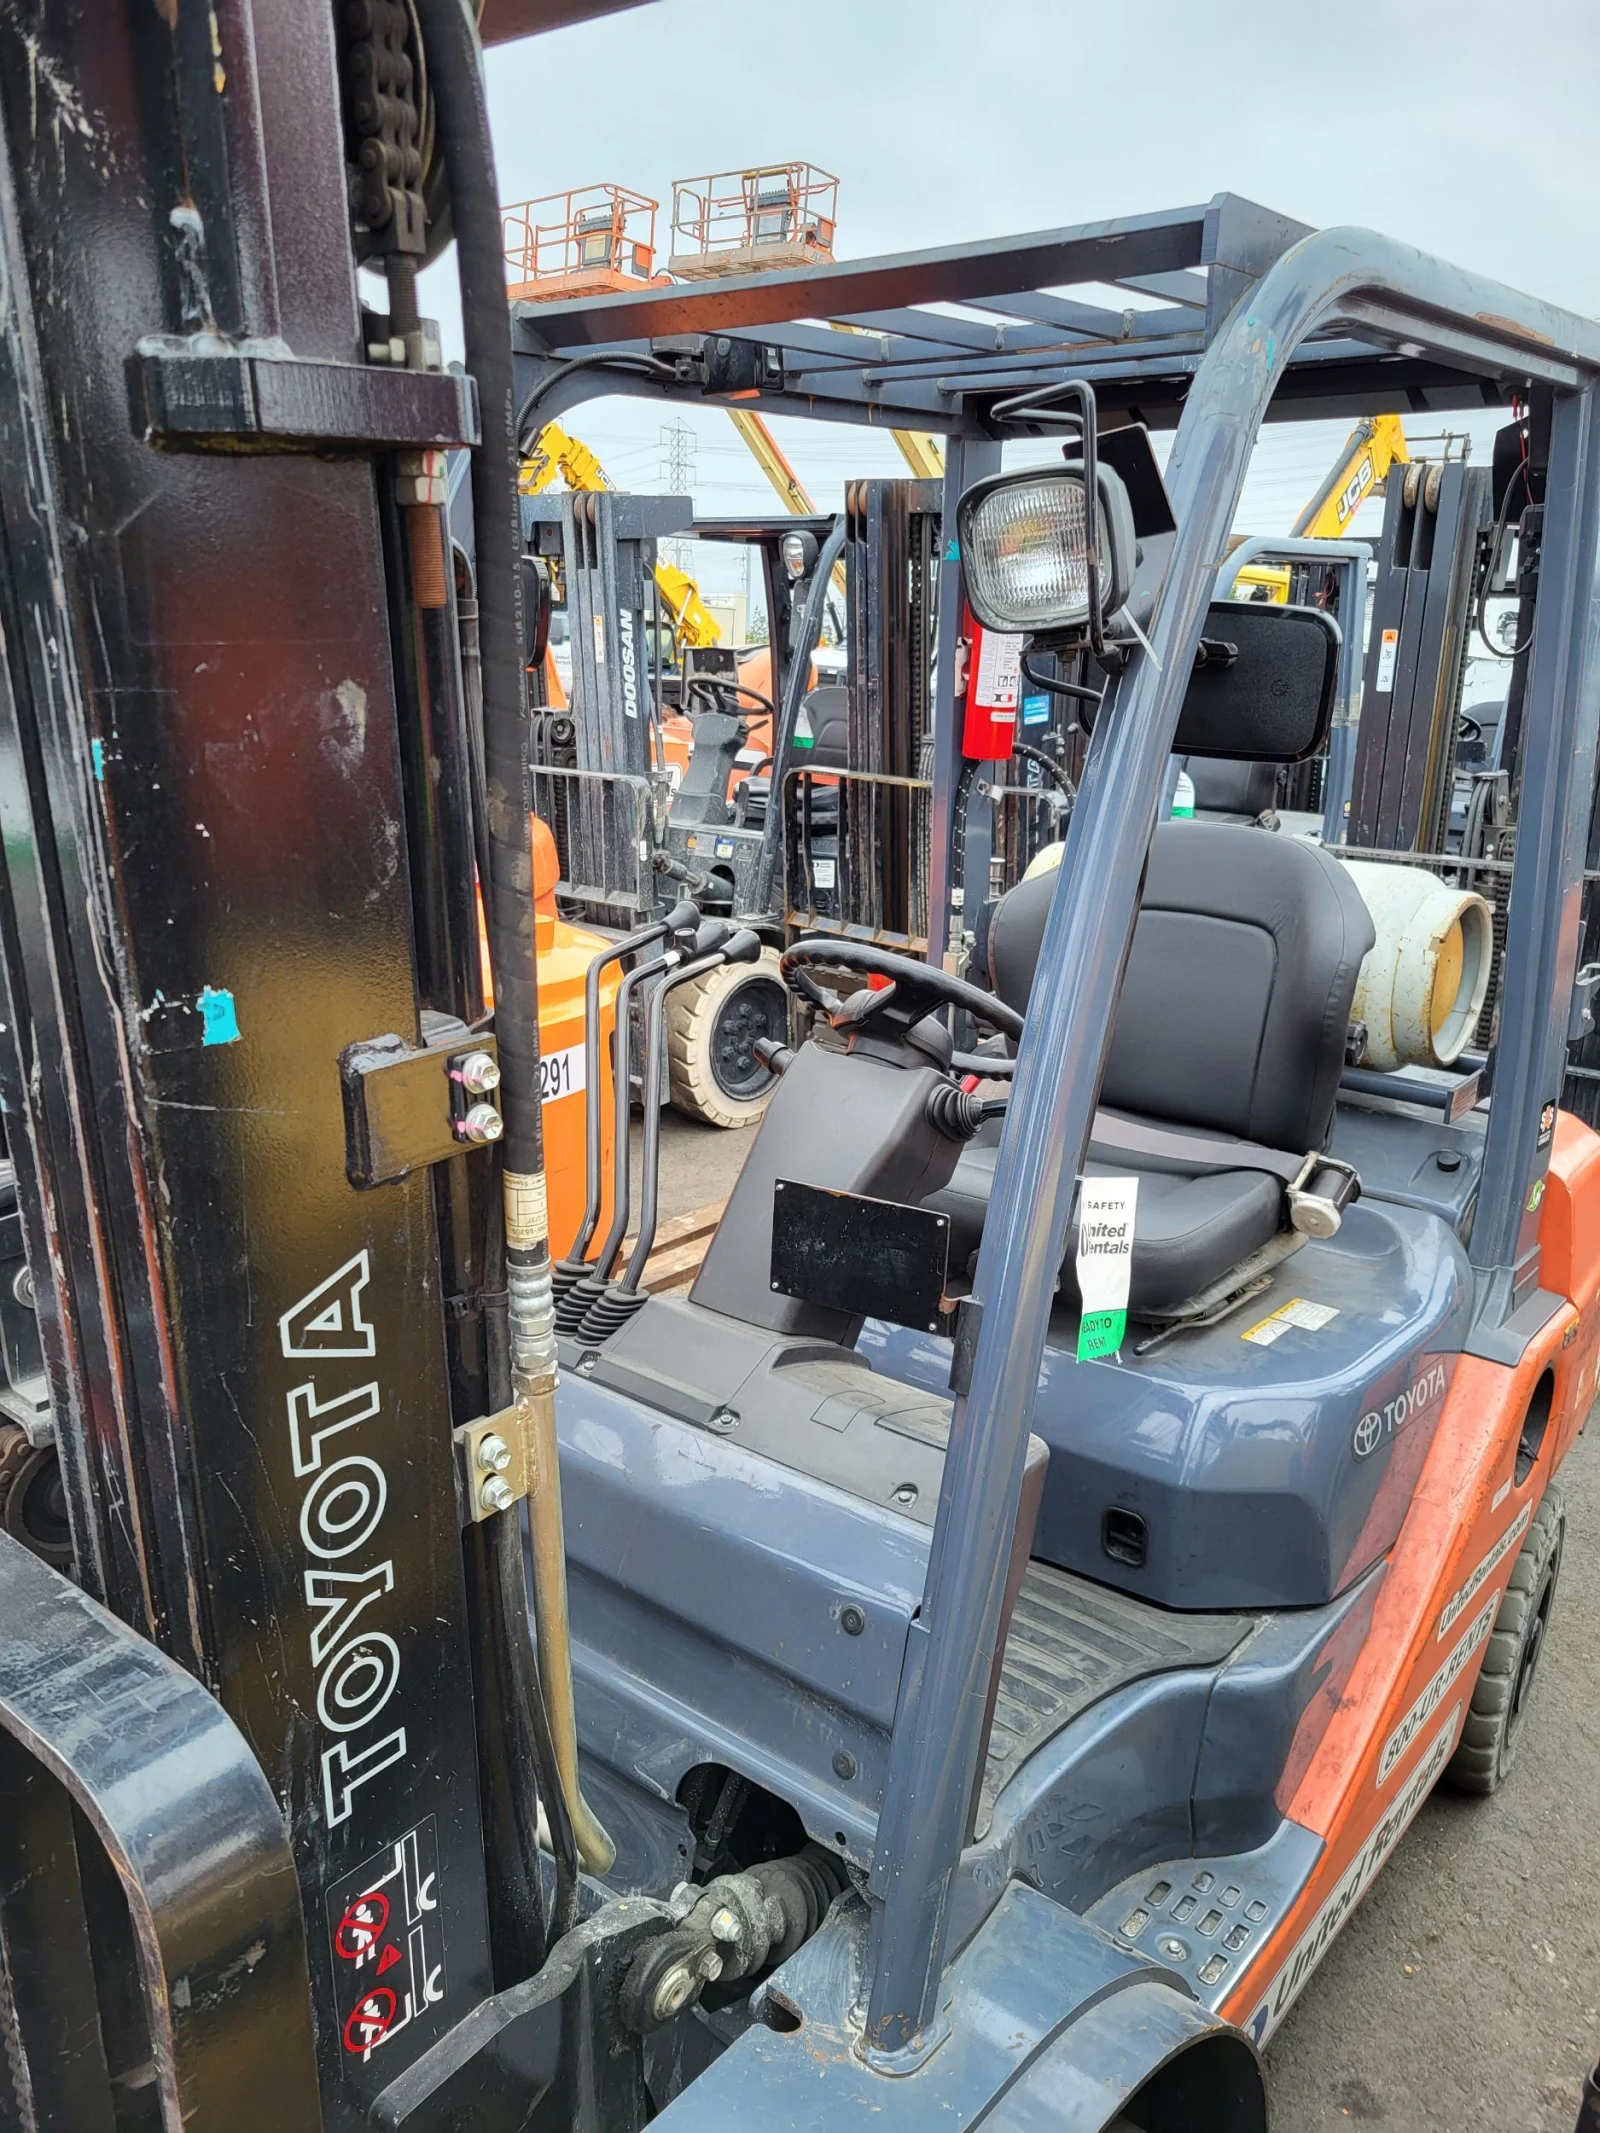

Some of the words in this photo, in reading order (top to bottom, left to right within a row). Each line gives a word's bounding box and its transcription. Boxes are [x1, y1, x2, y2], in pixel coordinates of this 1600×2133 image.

[1336, 458, 1373, 522] JCB
[619, 608, 638, 719] DOOSAN
[540, 1053, 570, 1098] 291
[1088, 1201, 1126, 1210] SAFETY
[1099, 1317, 1112, 1330] TO
[1383, 1364, 1445, 1432] TOYOTA
[279, 1248, 407, 1829] TOYOTA
[1384, 1601, 1494, 1771] 800-UR-RENTS
[1273, 1852, 1369, 2018] United
[1366, 1737, 1448, 1880] Rentals
